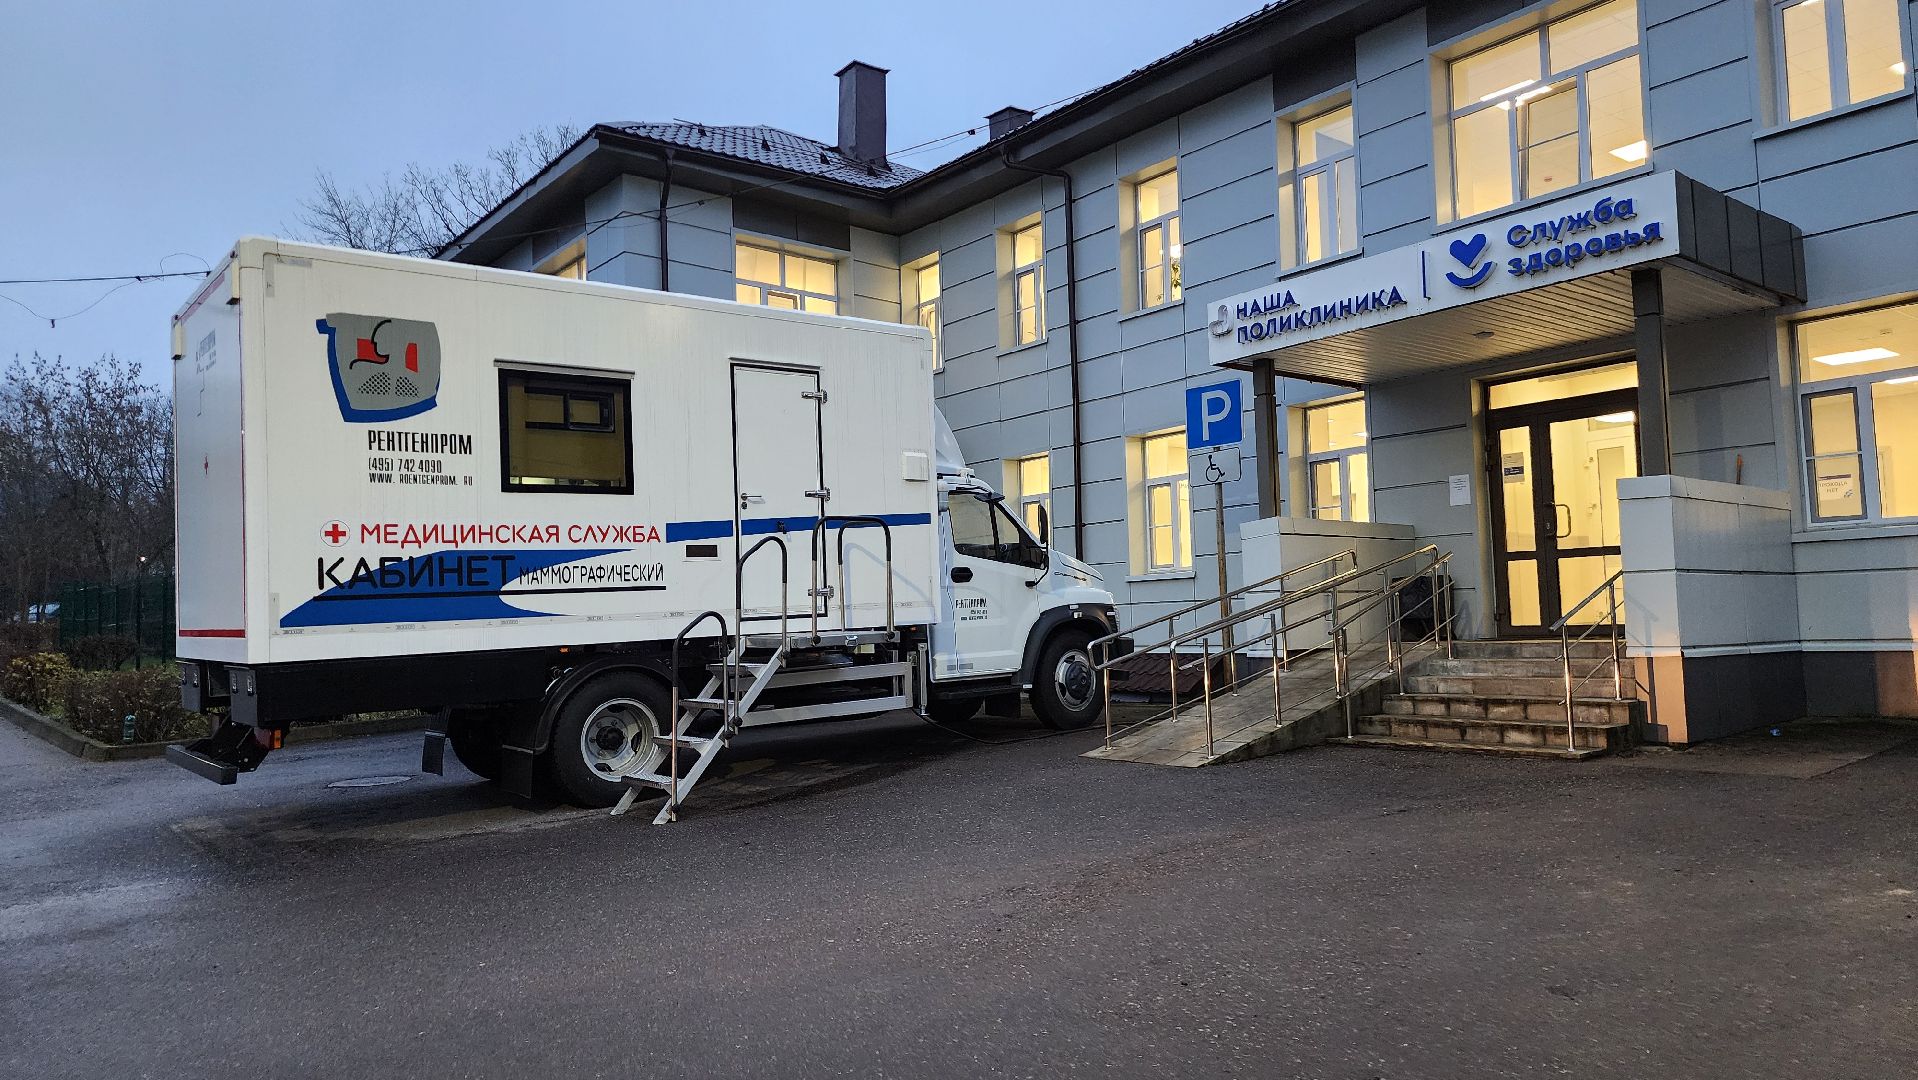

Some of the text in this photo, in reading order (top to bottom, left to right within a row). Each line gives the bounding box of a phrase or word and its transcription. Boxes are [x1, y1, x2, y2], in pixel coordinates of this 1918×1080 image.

[1506, 196, 1635, 247] Служба
[1507, 222, 1662, 275] здоровья
[1236, 289, 1297, 320] НАША
[1237, 286, 1405, 344] ПОЛИКЛИНИКА
[1201, 389, 1232, 441] P
[367, 429, 473, 455] РЕНТГЕНПРОМ
[368, 457, 442, 474] (495) 742 4090
[360, 523, 661, 549] МЕДИЦИНСКАЯ СЛУЖБА
[317, 554, 665, 591] КАБИНЕТ МАММОГРАФИЧЕСКИЙ
